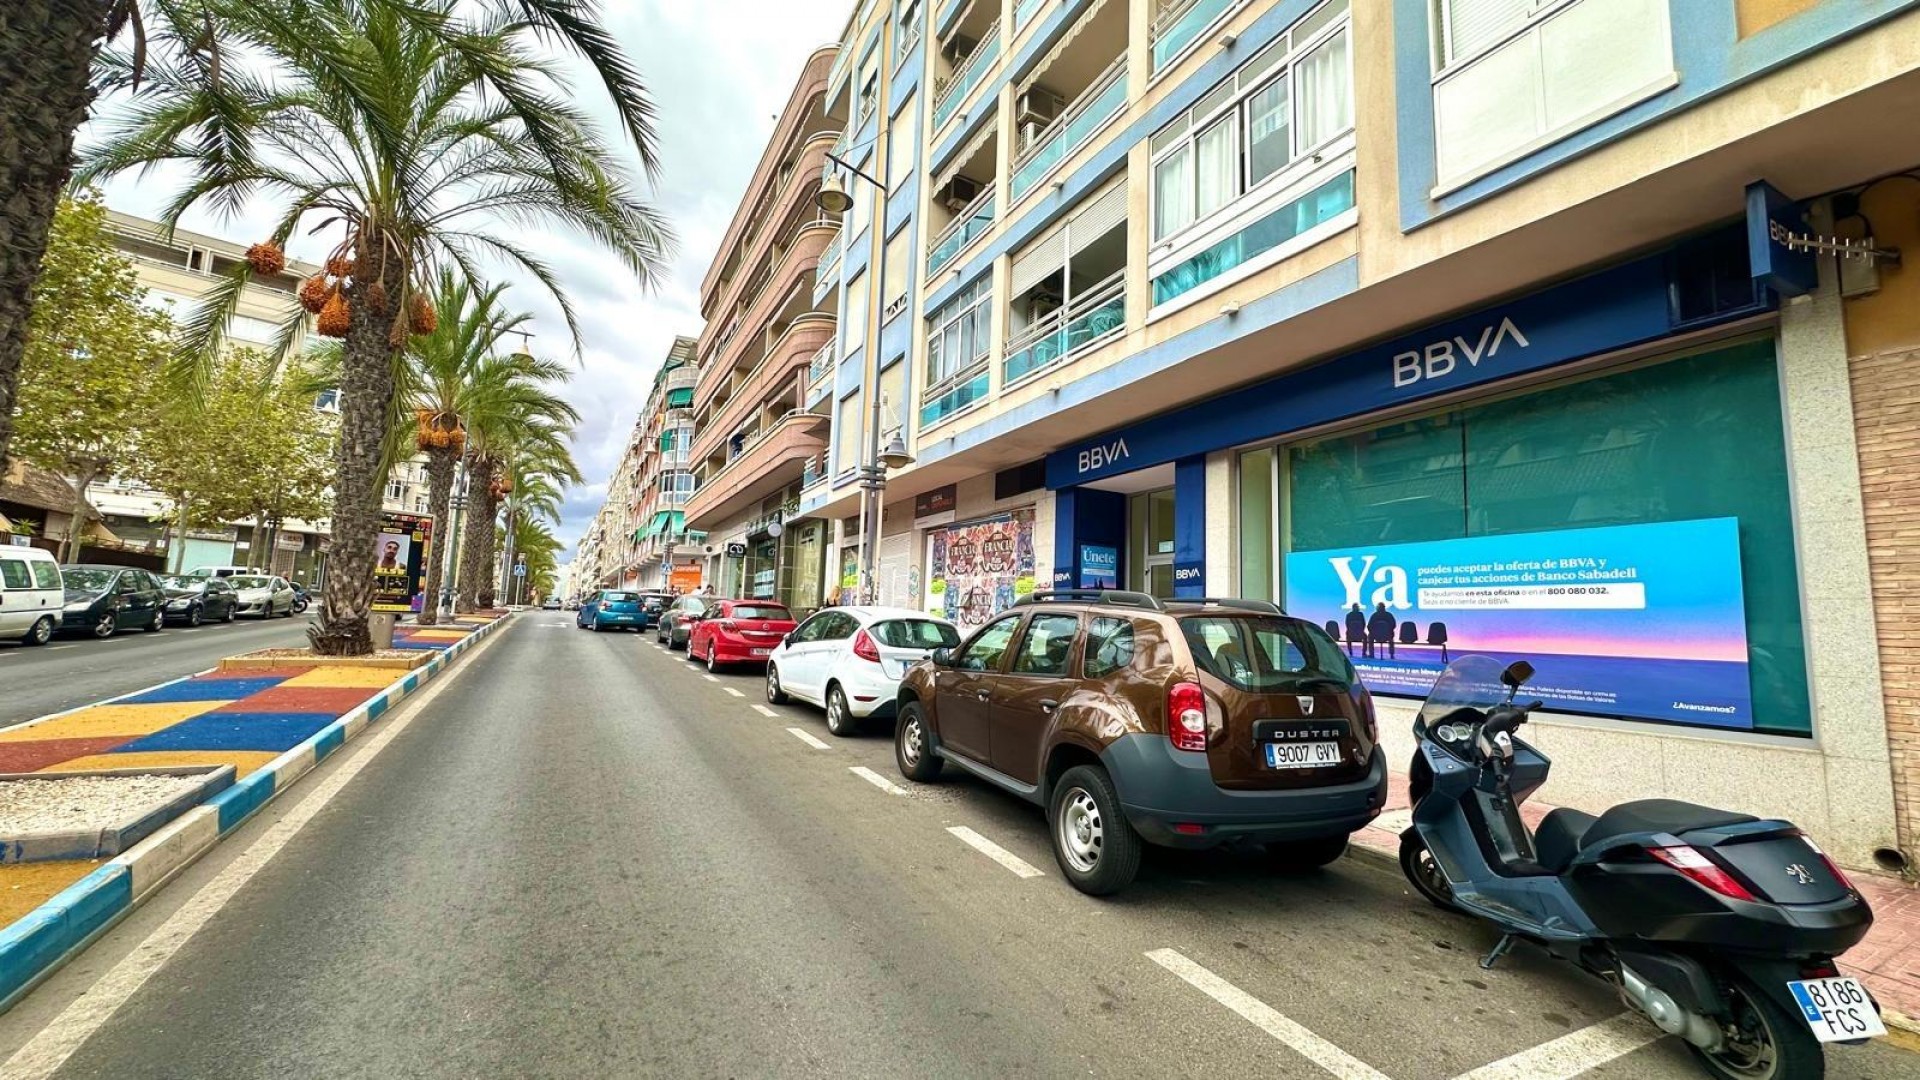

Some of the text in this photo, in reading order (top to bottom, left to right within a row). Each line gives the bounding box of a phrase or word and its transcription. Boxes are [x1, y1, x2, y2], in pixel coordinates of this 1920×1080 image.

[1393, 316, 1530, 388] BBVA
[1079, 437, 1130, 474] BBVA
[1083, 546, 1115, 564] Únete
[1176, 568, 1200, 579] BBVA
[1418, 558, 1607, 576] puedes aceptar la oferta de BBVA y
[1418, 567, 1637, 585] canjear tus acciones de Banco Sabadell
[1054, 572, 1071, 582] BBVA
[1328, 555, 1413, 610] Ya
[1493, 588, 1520, 596] oficina
[1547, 587, 1566, 595] 800
[1567, 587, 1586, 595] 080
[1673, 701, 1736, 714] ¿Avanzamos?
[1274, 730, 1340, 739] DUSTER
[1277, 745, 1309, 763] 9007
[1316, 743, 1338, 761] GVY
[1808, 979, 1863, 1008] 8186
[1822, 1007, 1867, 1035] FCS
